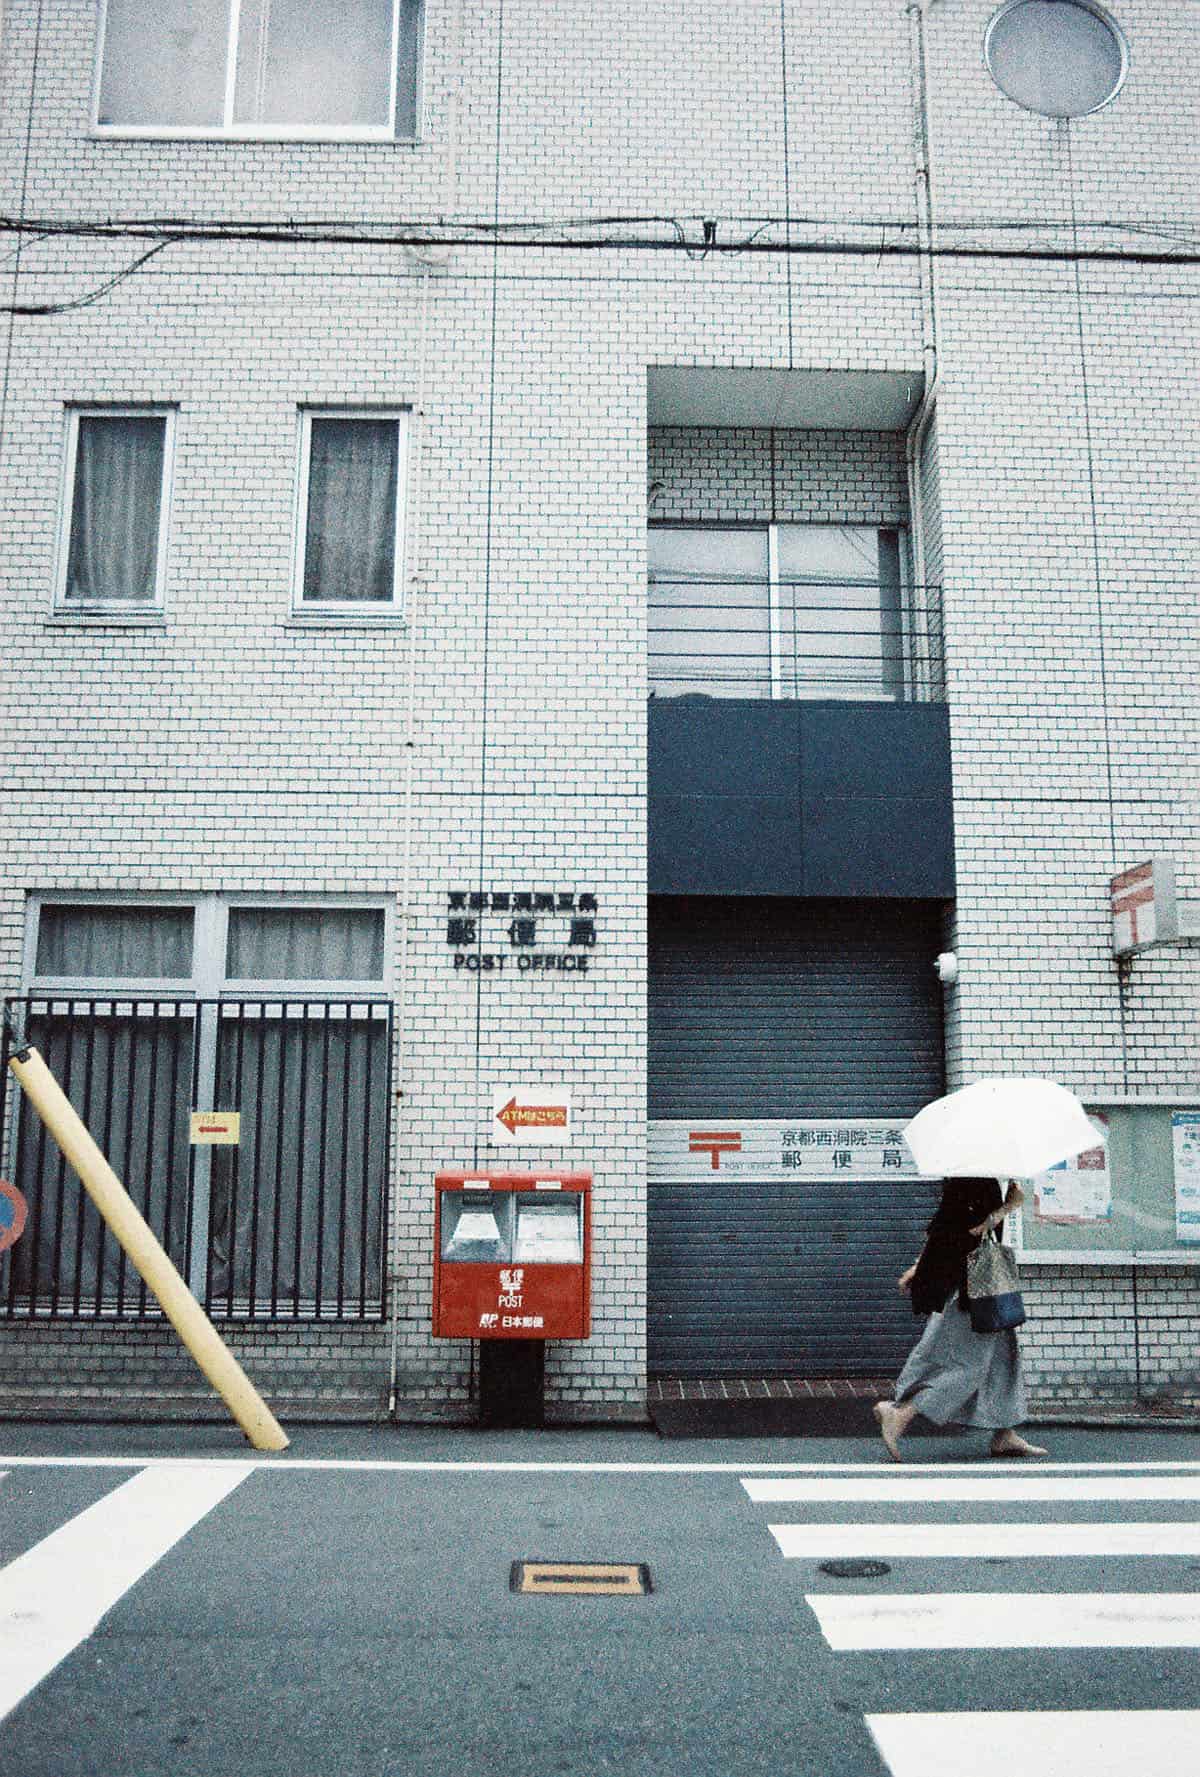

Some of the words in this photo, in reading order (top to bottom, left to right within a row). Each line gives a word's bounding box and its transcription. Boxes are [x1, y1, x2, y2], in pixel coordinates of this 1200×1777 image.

[454, 954, 507, 970] POST
[518, 954, 589, 971] OFFICE
[781, 1129, 903, 1146] 京都西洞院三条
[499, 1269, 524, 1284] 郵便
[498, 1295, 524, 1308] POST
[502, 1316, 545, 1328] 日本郵便
